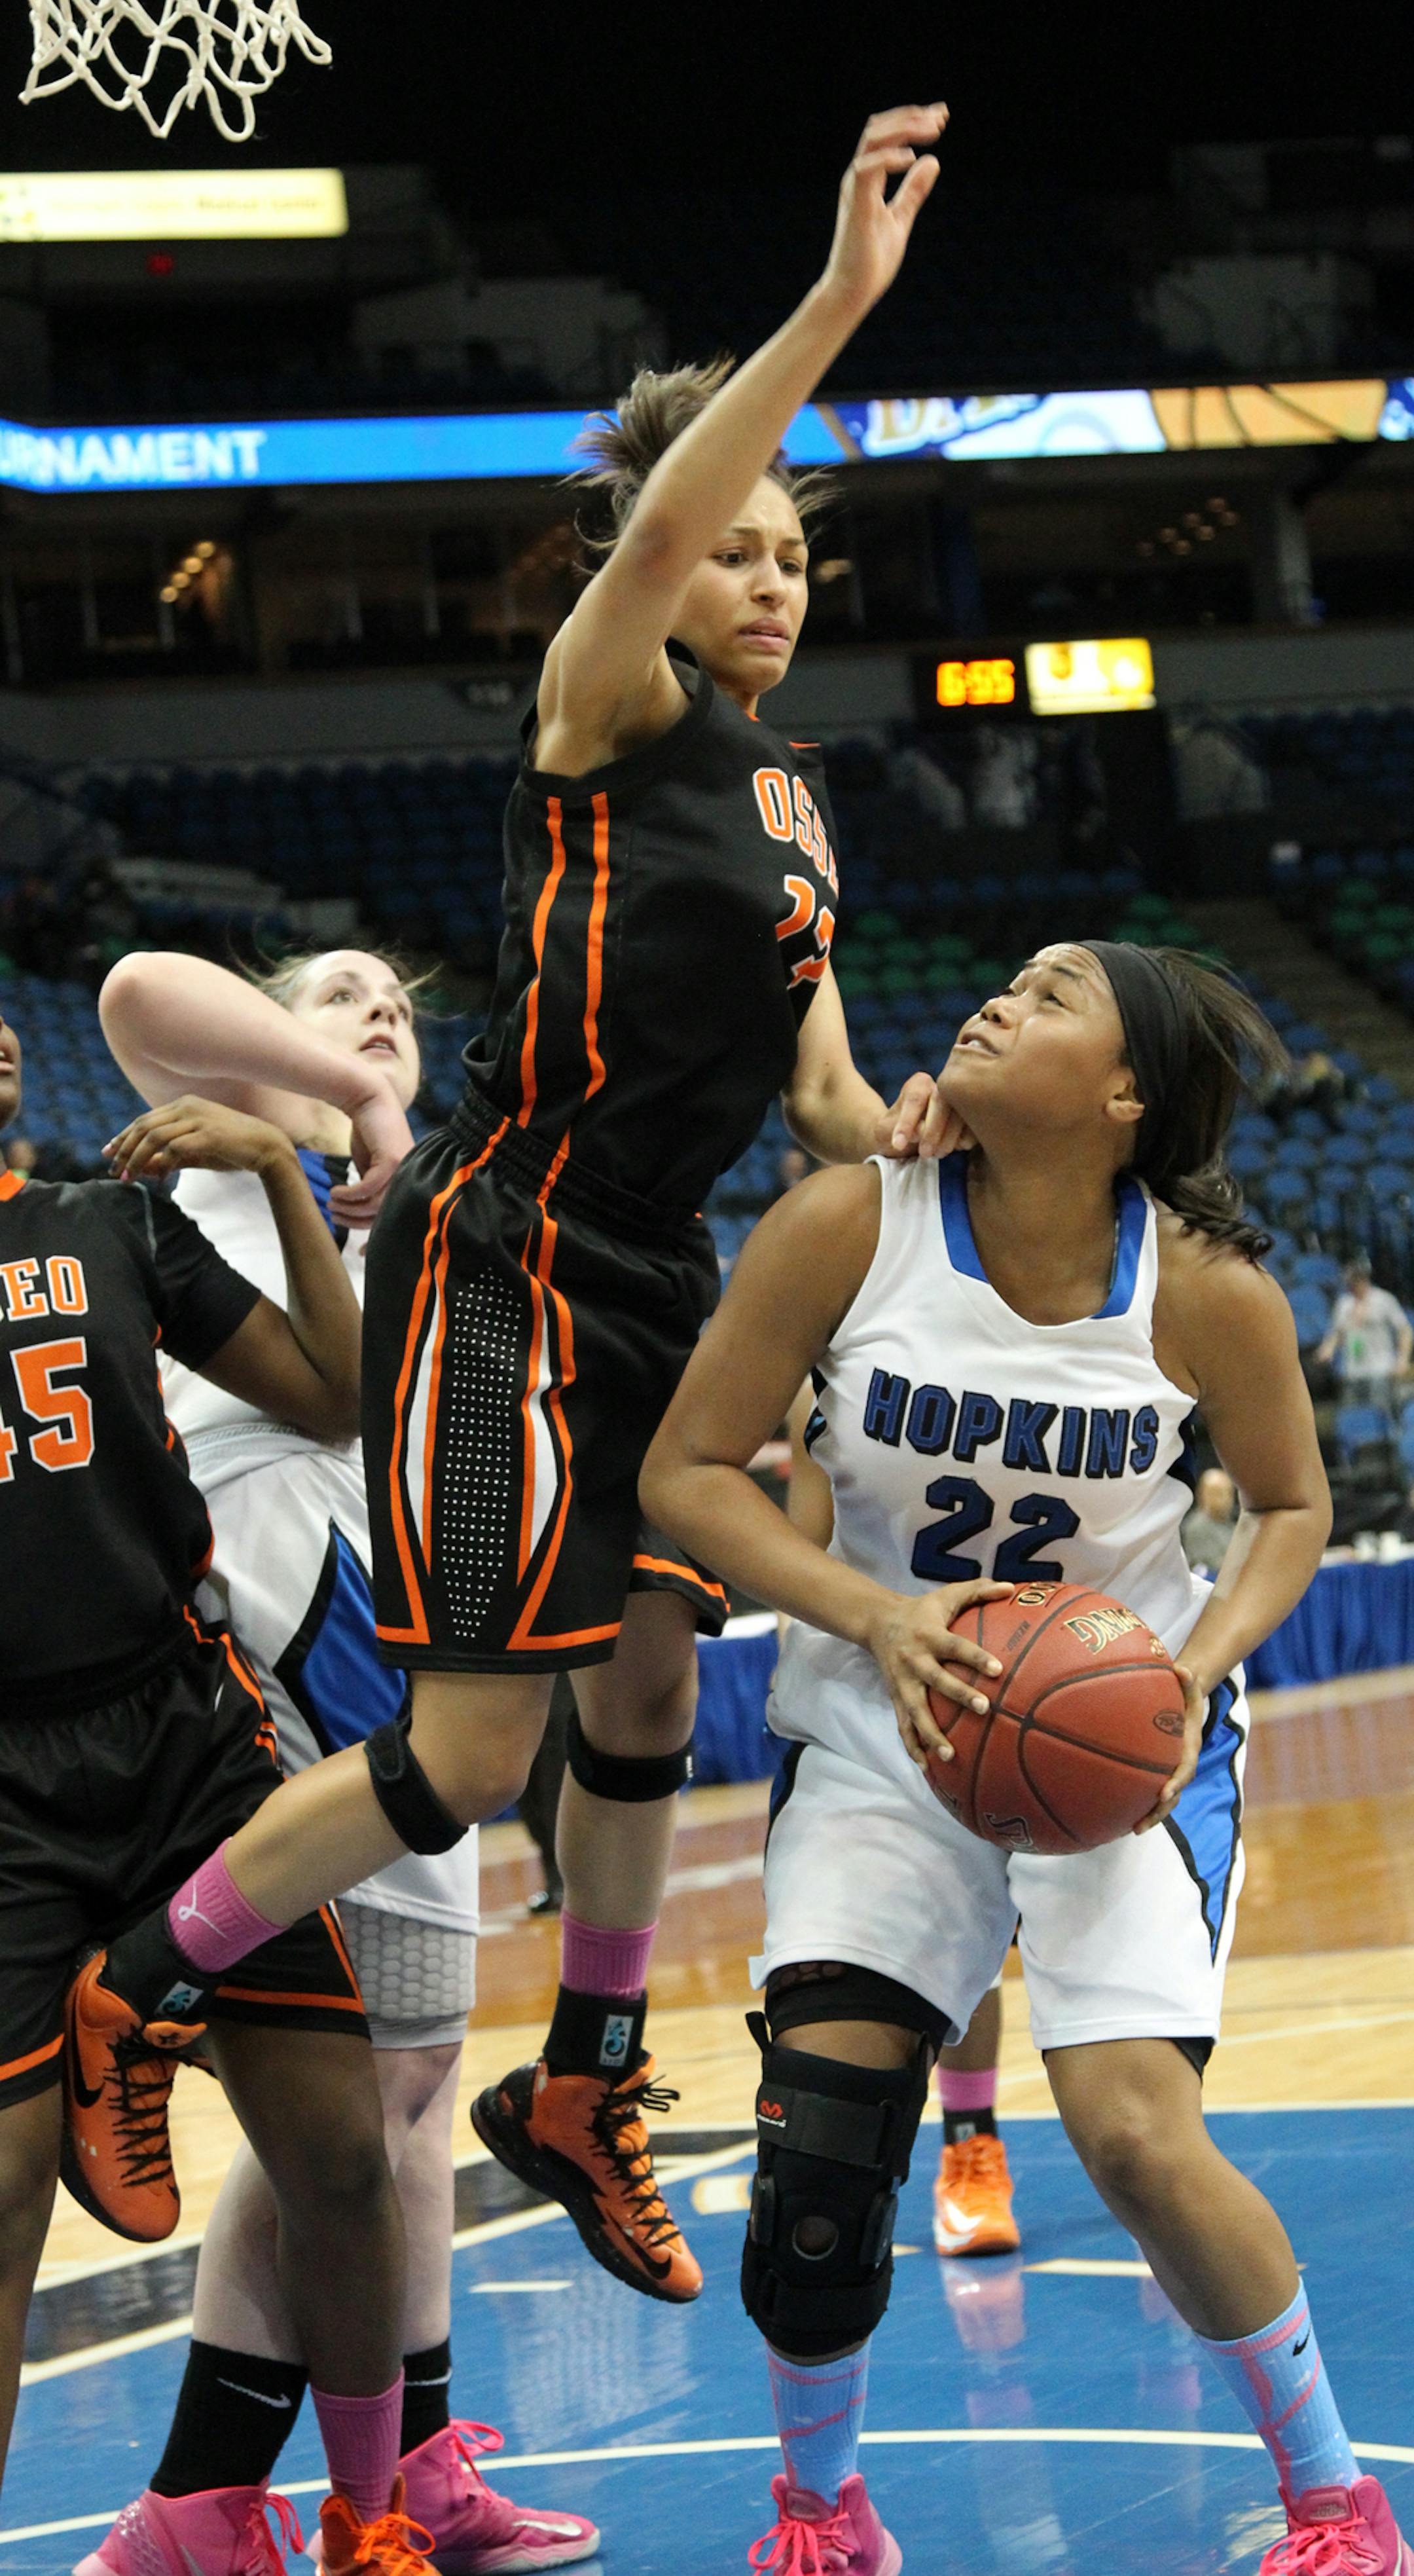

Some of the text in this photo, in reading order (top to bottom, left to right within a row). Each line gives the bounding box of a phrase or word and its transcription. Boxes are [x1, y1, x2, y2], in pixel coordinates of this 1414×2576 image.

[0, 1255, 88, 1321] EO
[863, 1367, 1159, 1479] HOPKINS
[911, 1475, 1081, 1583] 22
